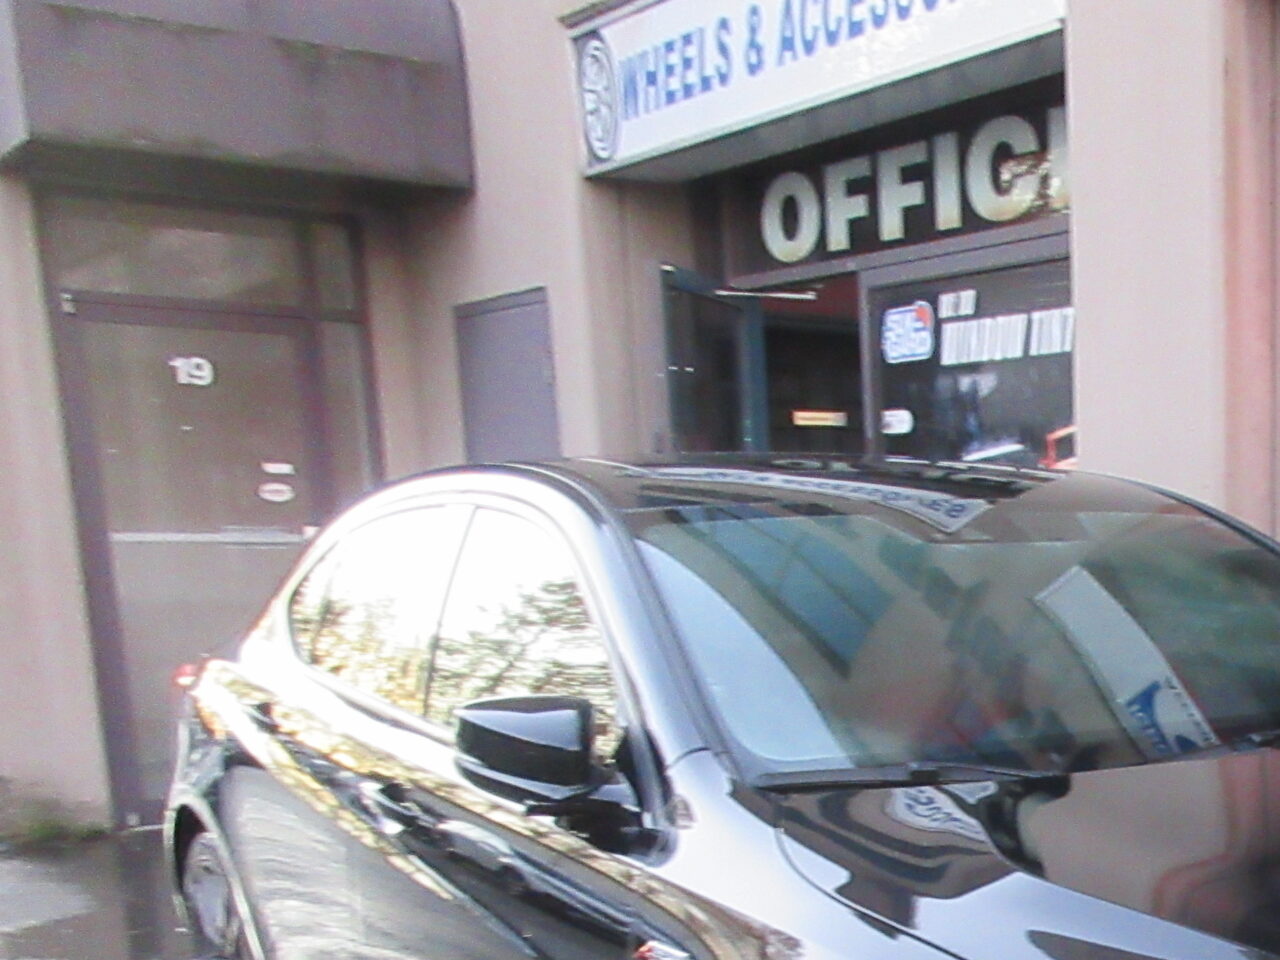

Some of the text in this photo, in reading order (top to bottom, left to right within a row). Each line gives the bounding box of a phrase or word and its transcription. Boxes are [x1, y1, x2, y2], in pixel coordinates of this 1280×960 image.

[619, 15, 732, 121] WHEELS
[746, 3, 764, 77] &
[168, 357, 215, 386] 19
